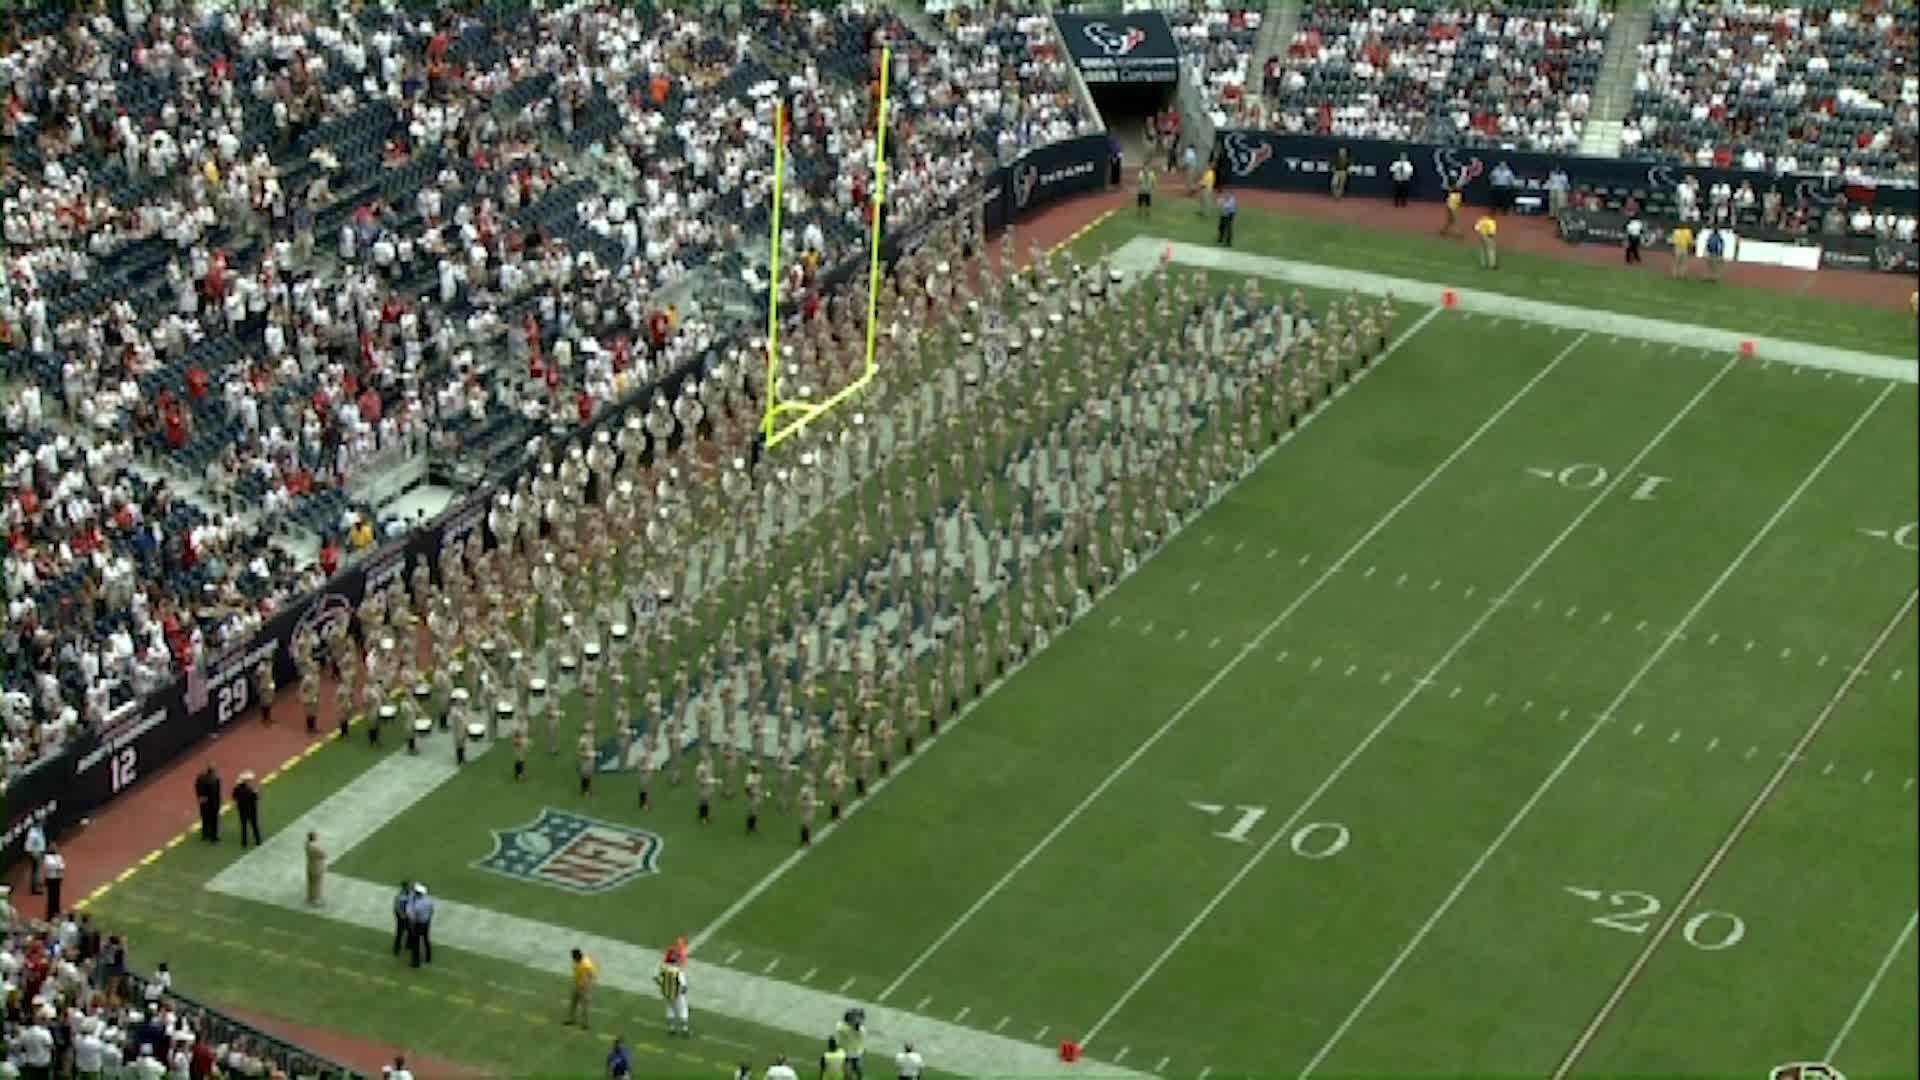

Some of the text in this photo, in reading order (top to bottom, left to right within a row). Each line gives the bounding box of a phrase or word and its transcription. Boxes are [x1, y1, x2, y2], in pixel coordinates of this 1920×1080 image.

[217, 676, 248, 723] 29
[110, 745, 138, 793] 12
[1212, 803, 1351, 860] 10
[541, 832, 646, 884] NFL
[1592, 889, 1746, 952] 20
